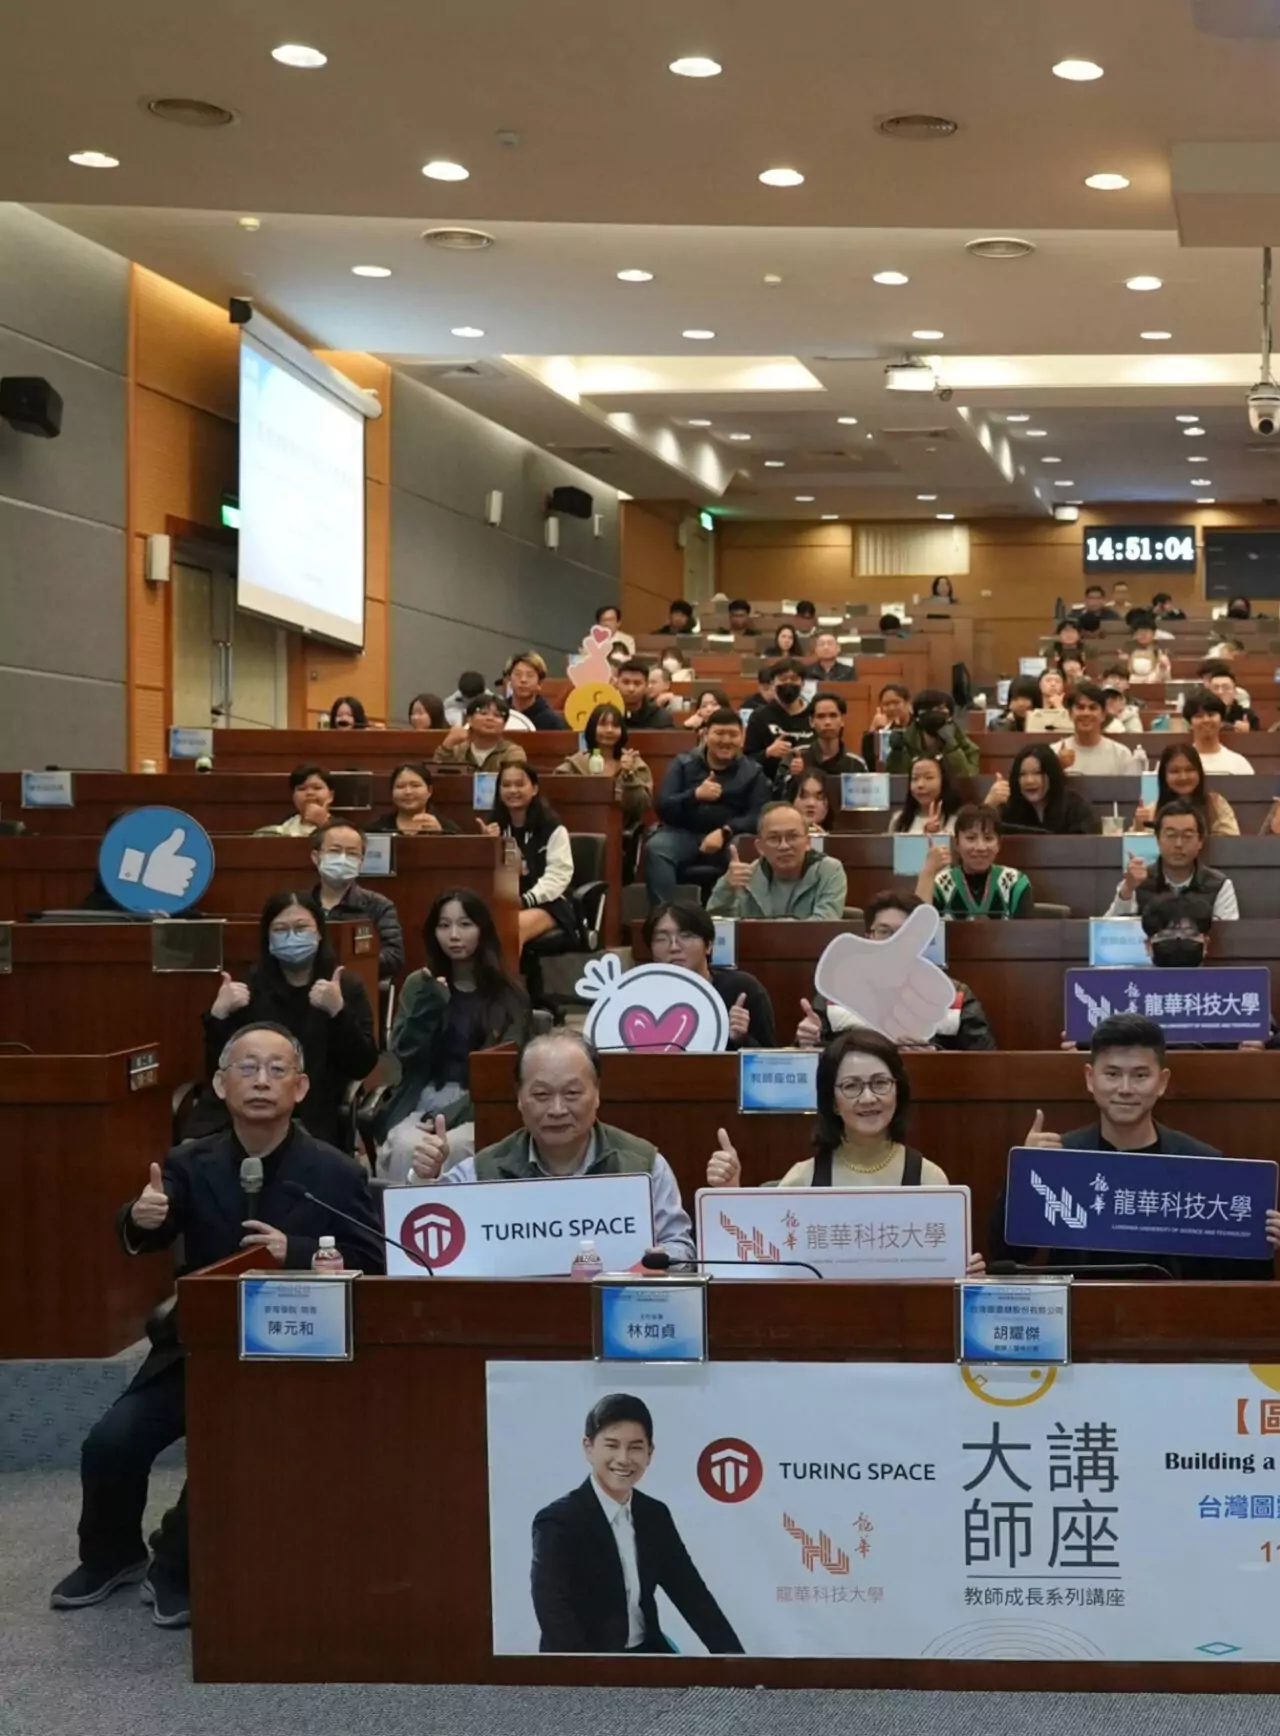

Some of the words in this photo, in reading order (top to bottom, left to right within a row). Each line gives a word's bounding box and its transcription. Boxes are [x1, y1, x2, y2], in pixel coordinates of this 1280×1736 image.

[1086, 536, 1194, 560] 14:51:04
[1144, 992, 1260, 1017] 龍華科技大學
[1113, 1188, 1253, 1222] 龍華科技大學
[480, 1219, 564, 1242] TURING
[568, 1216, 637, 1237] SPACE
[805, 1222, 947, 1250] 龍華科技大學
[268, 1320, 314, 1336] 陳元和
[627, 1323, 676, 1339] 林如貞
[993, 1325, 1040, 1341] 胡耀傑
[779, 1461, 862, 1481] TURING
[868, 1462, 936, 1481] SPACE
[1164, 1451, 1256, 1475] Building
[1263, 1456, 1276, 1471] a
[775, 1584, 885, 1604] 龍華科技大學
[964, 1586, 1126, 1608] 教師成長系列講座
